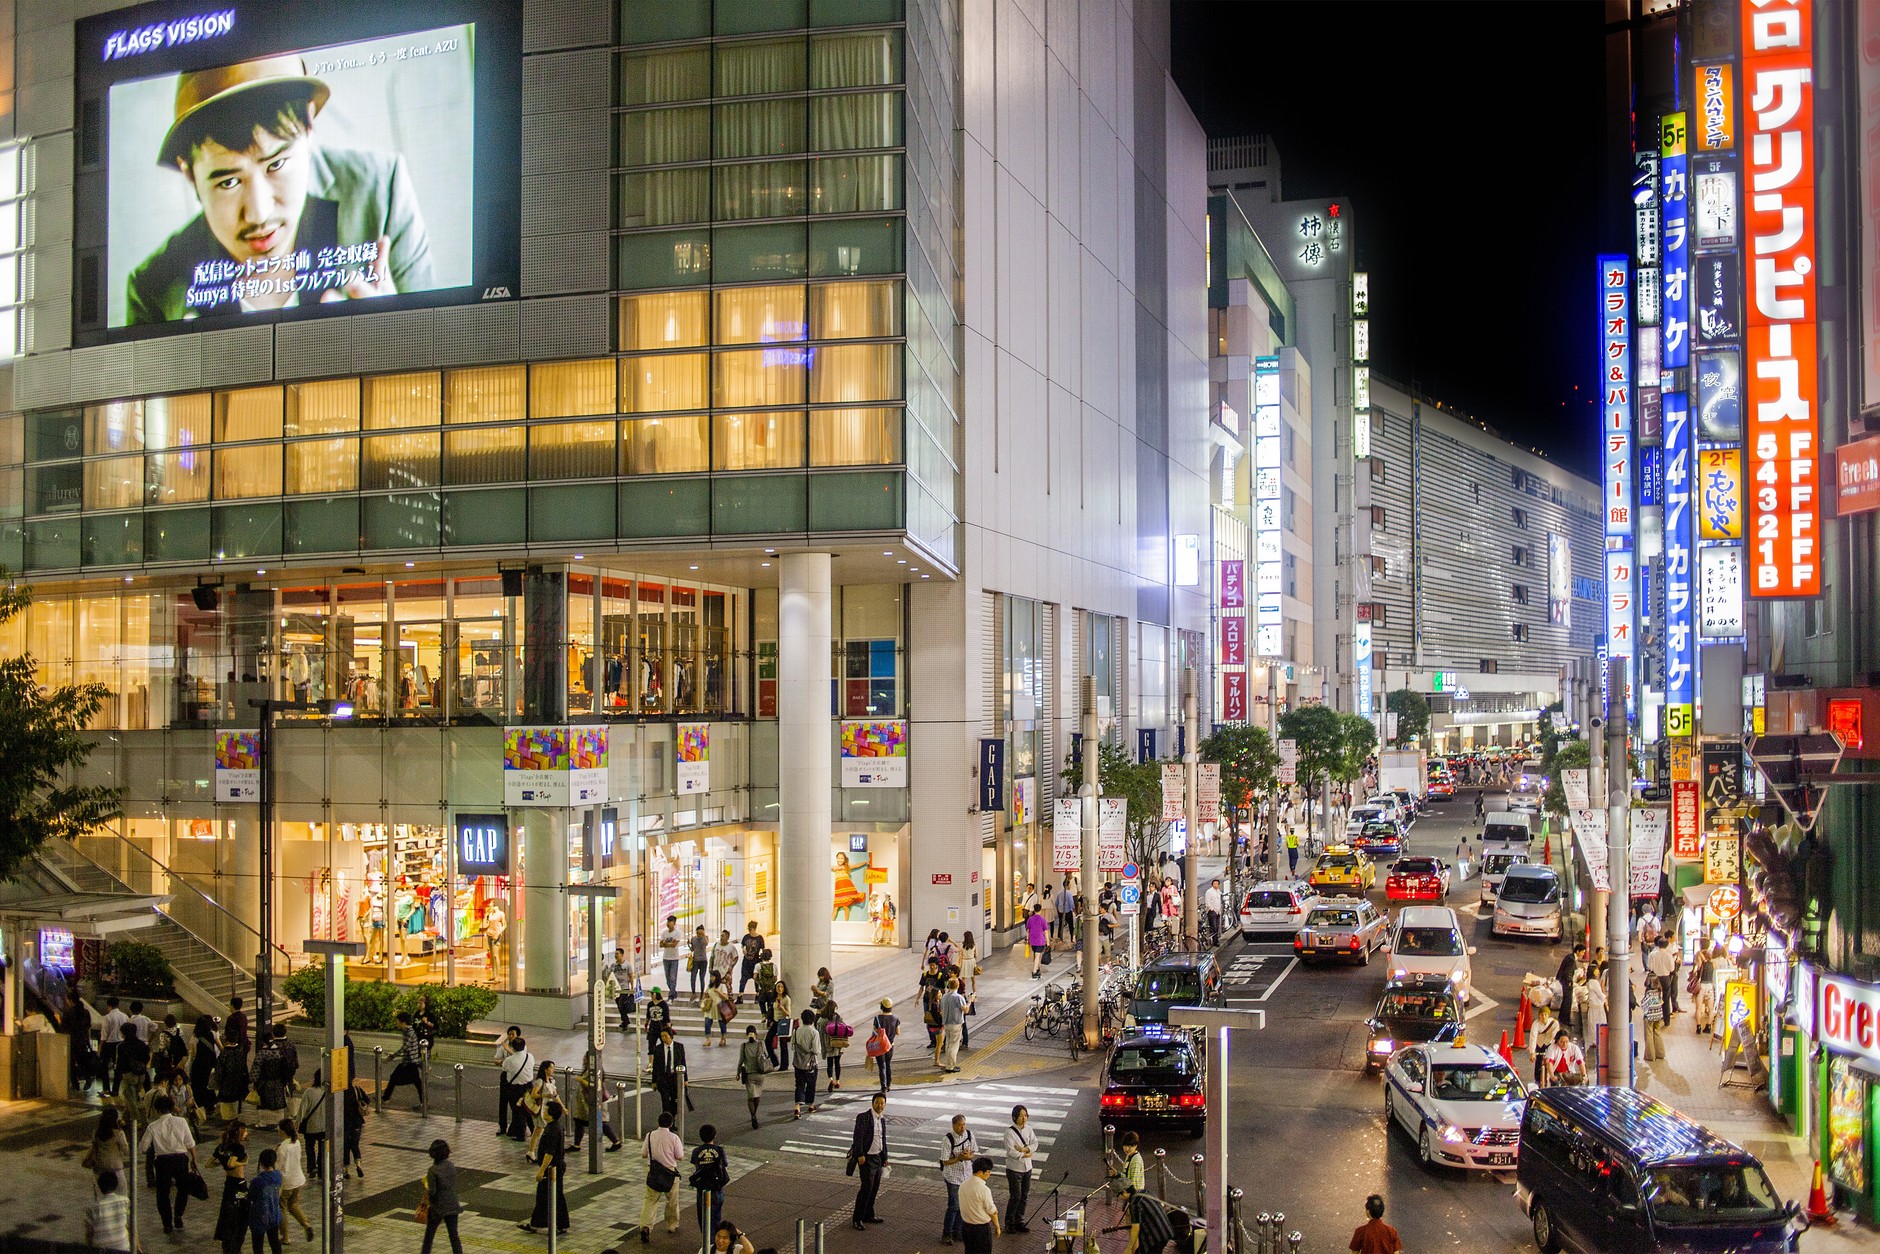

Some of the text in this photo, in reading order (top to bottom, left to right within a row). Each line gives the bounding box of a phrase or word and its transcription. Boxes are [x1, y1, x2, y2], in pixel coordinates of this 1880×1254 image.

[105, 11, 233, 60] FLAGS VISION
[320, 61, 335, 73] To
[369, 47, 406, 66] もう一度
[410, 45, 432, 59] feat.
[434, 38, 458, 54] AZU
[1704, 67, 1729, 149] タウンハウジング
[1663, 123, 1685, 148] 5F
[1709, 161, 1721, 172] 5F
[193, 242, 379, 284] 配信ヒットコラボ曲 完全収録
[1713, 261, 1724, 306] 博多もつ鍋
[186, 287, 228, 309] Sunya
[1642, 392, 1658, 435] エピレ
[1664, 169, 1690, 692] カラオケ 747 カラオケ
[1709, 452, 1734, 466] 2F
[1643, 467, 1651, 497] 日本旅行
[1226, 563, 1238, 607] パチンコ
[1227, 621, 1239, 662] スロット
[1229, 676, 1241, 719] マルハン
[1669, 708, 1691, 731] 5F
[987, 744, 996, 807] GAP
[463, 827, 497, 863] GAP
[1733, 985, 1750, 996] 2F
[1824, 982, 1880, 1050] Gre
